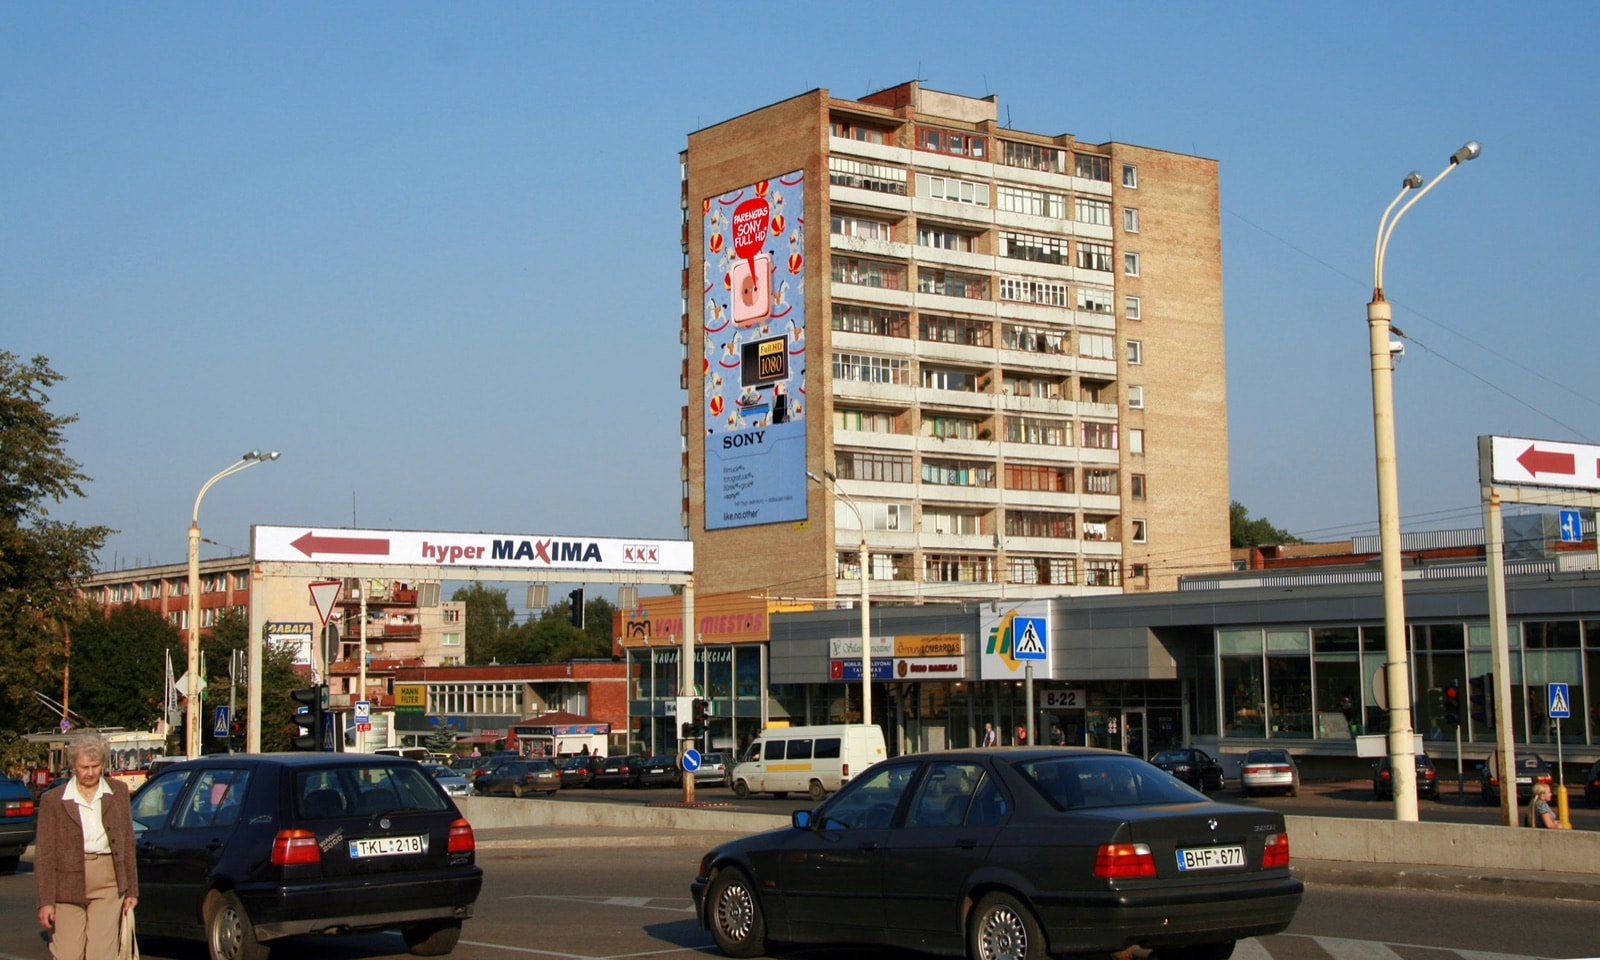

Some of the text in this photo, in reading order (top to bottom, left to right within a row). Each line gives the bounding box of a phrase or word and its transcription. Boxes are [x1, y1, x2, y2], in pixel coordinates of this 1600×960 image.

[733, 206, 768, 225] PARENGTAS
[737, 219, 762, 237] SONY
[734, 230, 766, 248] FULL HD
[760, 342, 782, 354] Full HD
[761, 354, 783, 375] 1080
[723, 430, 766, 449] SONY
[421, 541, 486, 563] hyper
[491, 538, 603, 565] MAXIMA
[701, 612, 762, 635] MIESTAS
[401, 687, 419, 696] MANN
[401, 695, 419, 704] FILTER
[359, 840, 388, 855] TKL
[396, 838, 419, 852] 218
[1185, 850, 1212, 867] BHF
[1220, 848, 1241, 865] 677
